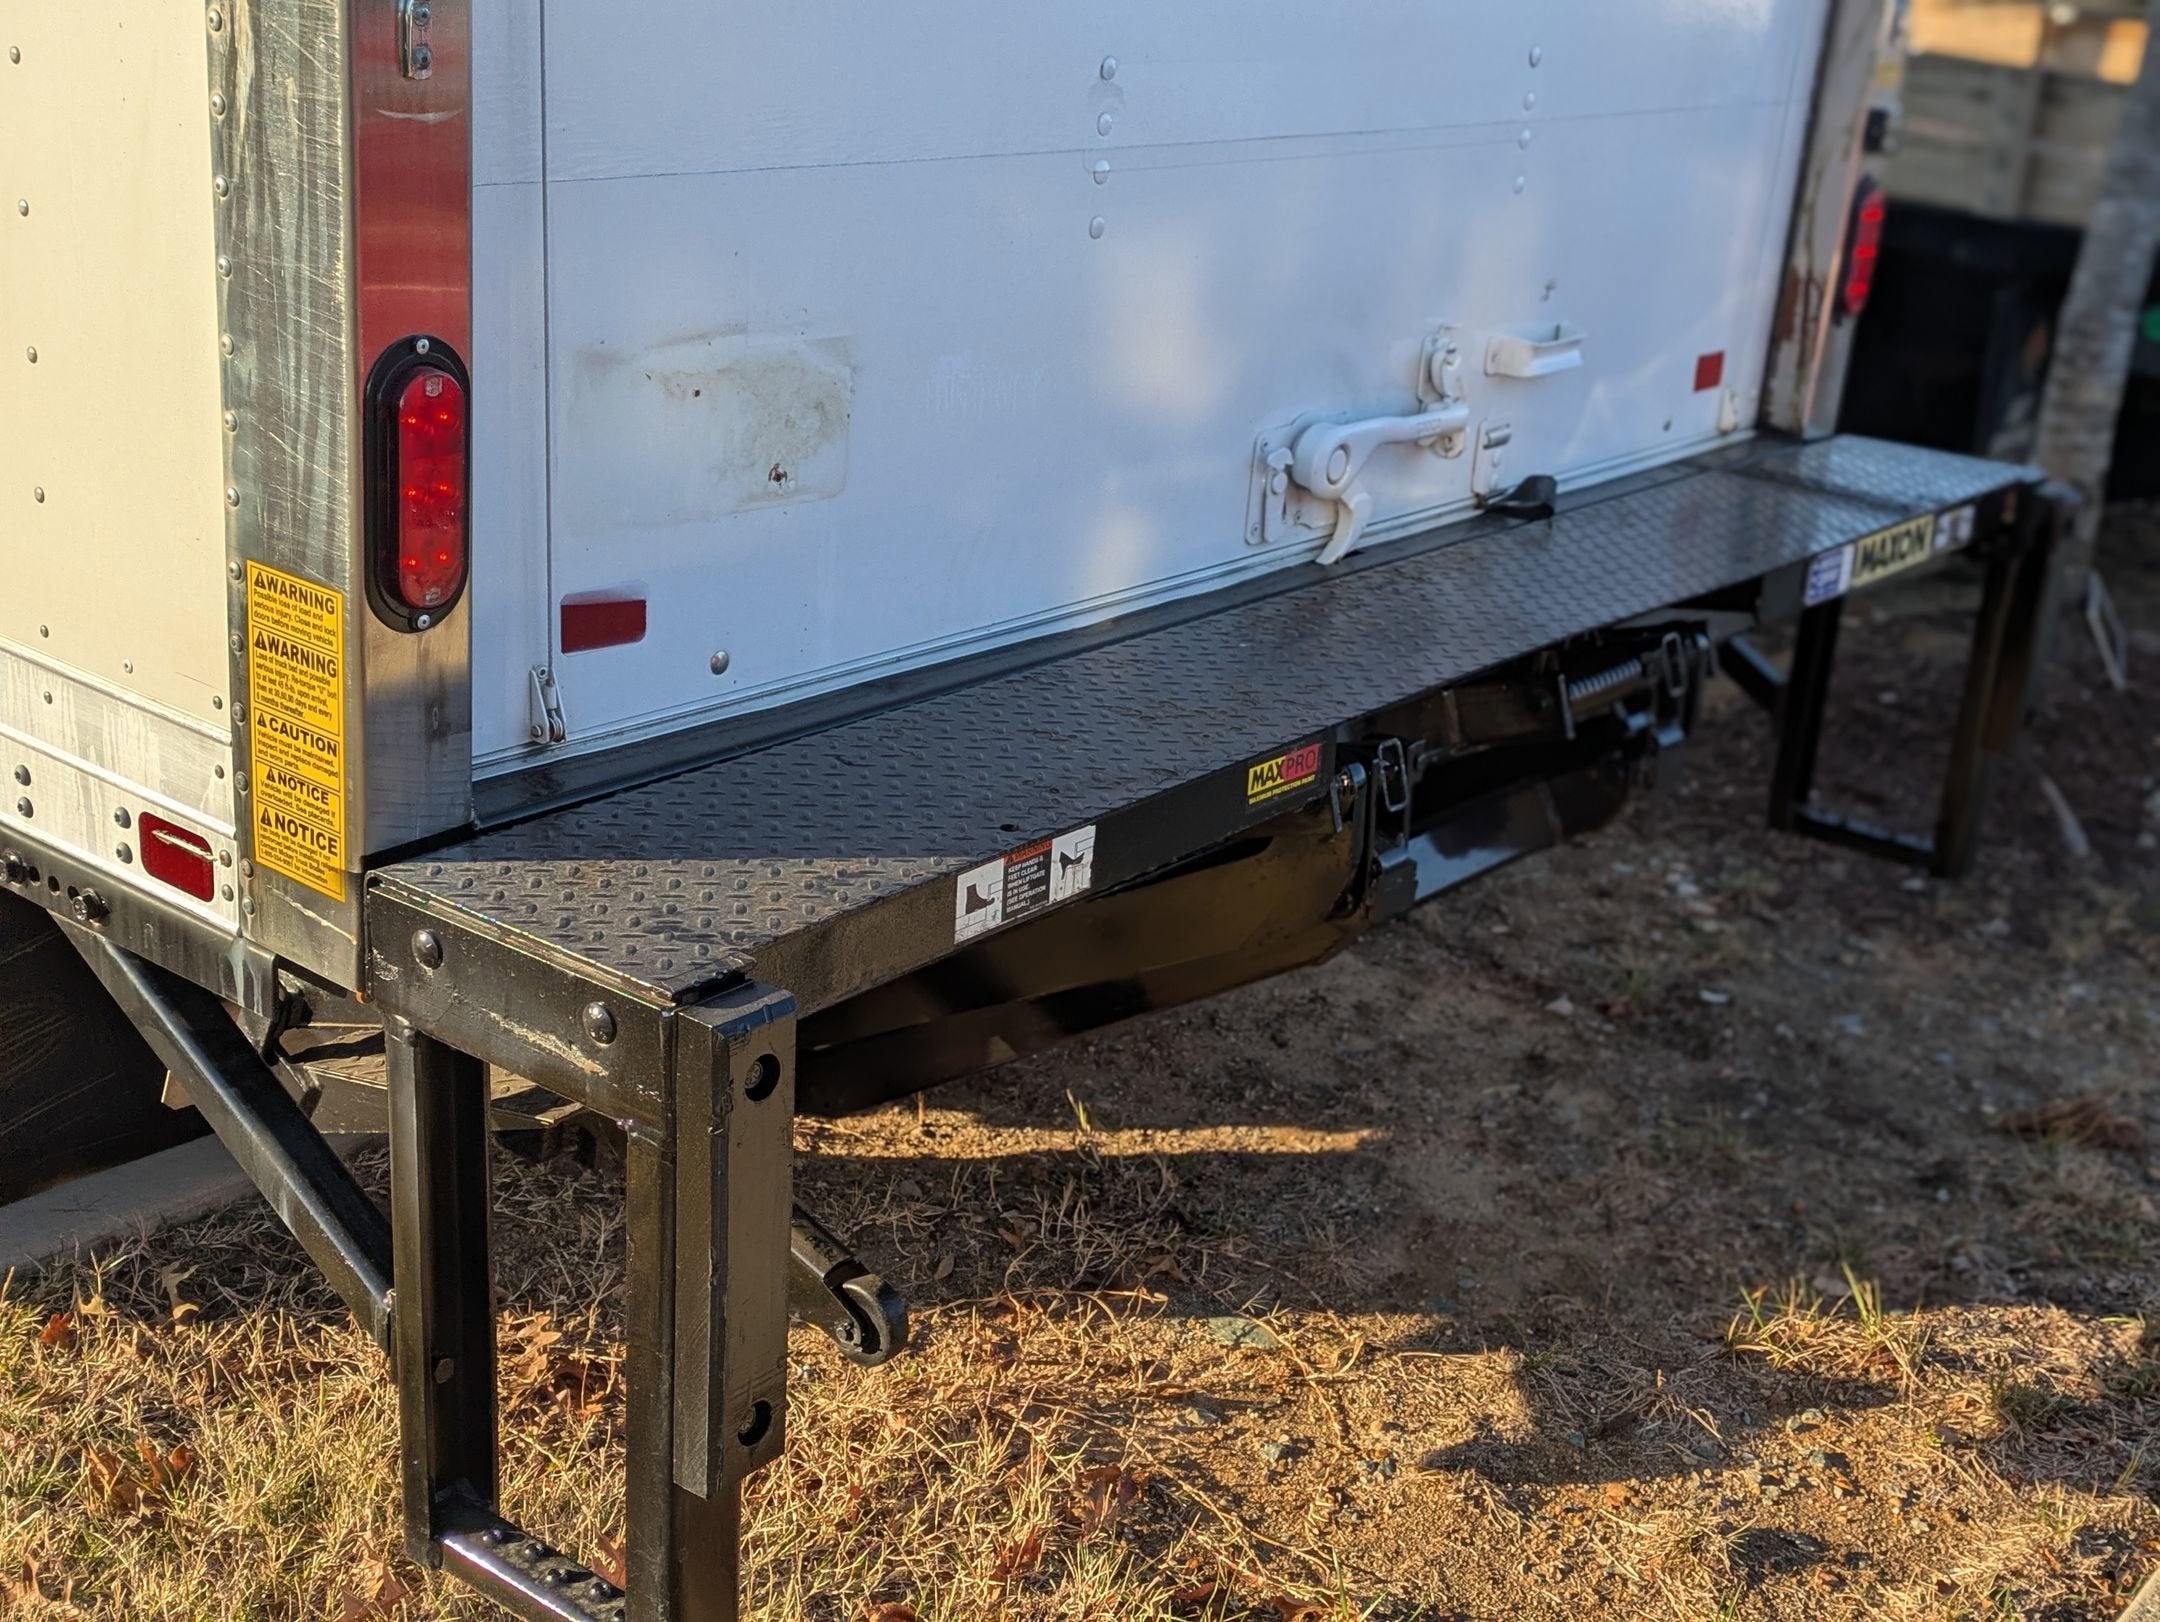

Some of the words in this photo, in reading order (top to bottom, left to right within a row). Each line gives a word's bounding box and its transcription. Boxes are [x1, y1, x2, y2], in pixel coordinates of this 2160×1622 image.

[254, 589, 277, 604] Possible
[279, 599, 290, 609] loss
[299, 606, 311, 616] load
[313, 612, 323, 621] and
[266, 575, 335, 615] WARNING
[254, 600, 274, 613] serious
[295, 615, 311, 627] Close
[312, 622, 323, 632] and
[324, 626, 336, 637] lock
[254, 611, 270, 622] doors
[272, 617, 289, 630] before
[290, 625, 311, 640] moving
[256, 662, 274, 674] serious
[256, 650, 267, 661] Loss
[275, 658, 286, 668] truck
[288, 663, 298, 673] bed
[299, 668, 308, 677] and
[309, 672, 330, 687] possible
[267, 635, 336, 678] WARNING
[257, 682, 267, 692] then
[295, 698, 306, 710] days
[308, 703, 317, 712] and
[319, 708, 332, 720] every
[261, 695, 278, 707] months
[268, 676, 276, 685] least
[297, 689, 310, 701] upon
[258, 729, 277, 742] Vehicle
[279, 739, 292, 749] must
[269, 717, 337, 757] CAUTION
[258, 739, 277, 753] Inspect
[279, 748, 289, 756] and
[291, 753, 311, 767] replace
[312, 762, 338, 779] damaged
[270, 754, 283, 763] worn
[1250, 750, 1316, 791] MAXPRO
[261, 780, 281, 794] Vehicle
[283, 790, 293, 799] will
[294, 795, 301, 803] be
[303, 799, 329, 817] damaged
[261, 789, 294, 809] overloaded.
[296, 804, 307, 814] See
[278, 772, 328, 805] NOTICE
[269, 829, 280, 839] body
[297, 843, 317, 857] damaged
[275, 812, 337, 856] NOTICE
[284, 844, 298, 854] before
[1021, 866, 1037, 876] CLEAR
[1023, 870, 1045, 883] LIFTGATE
